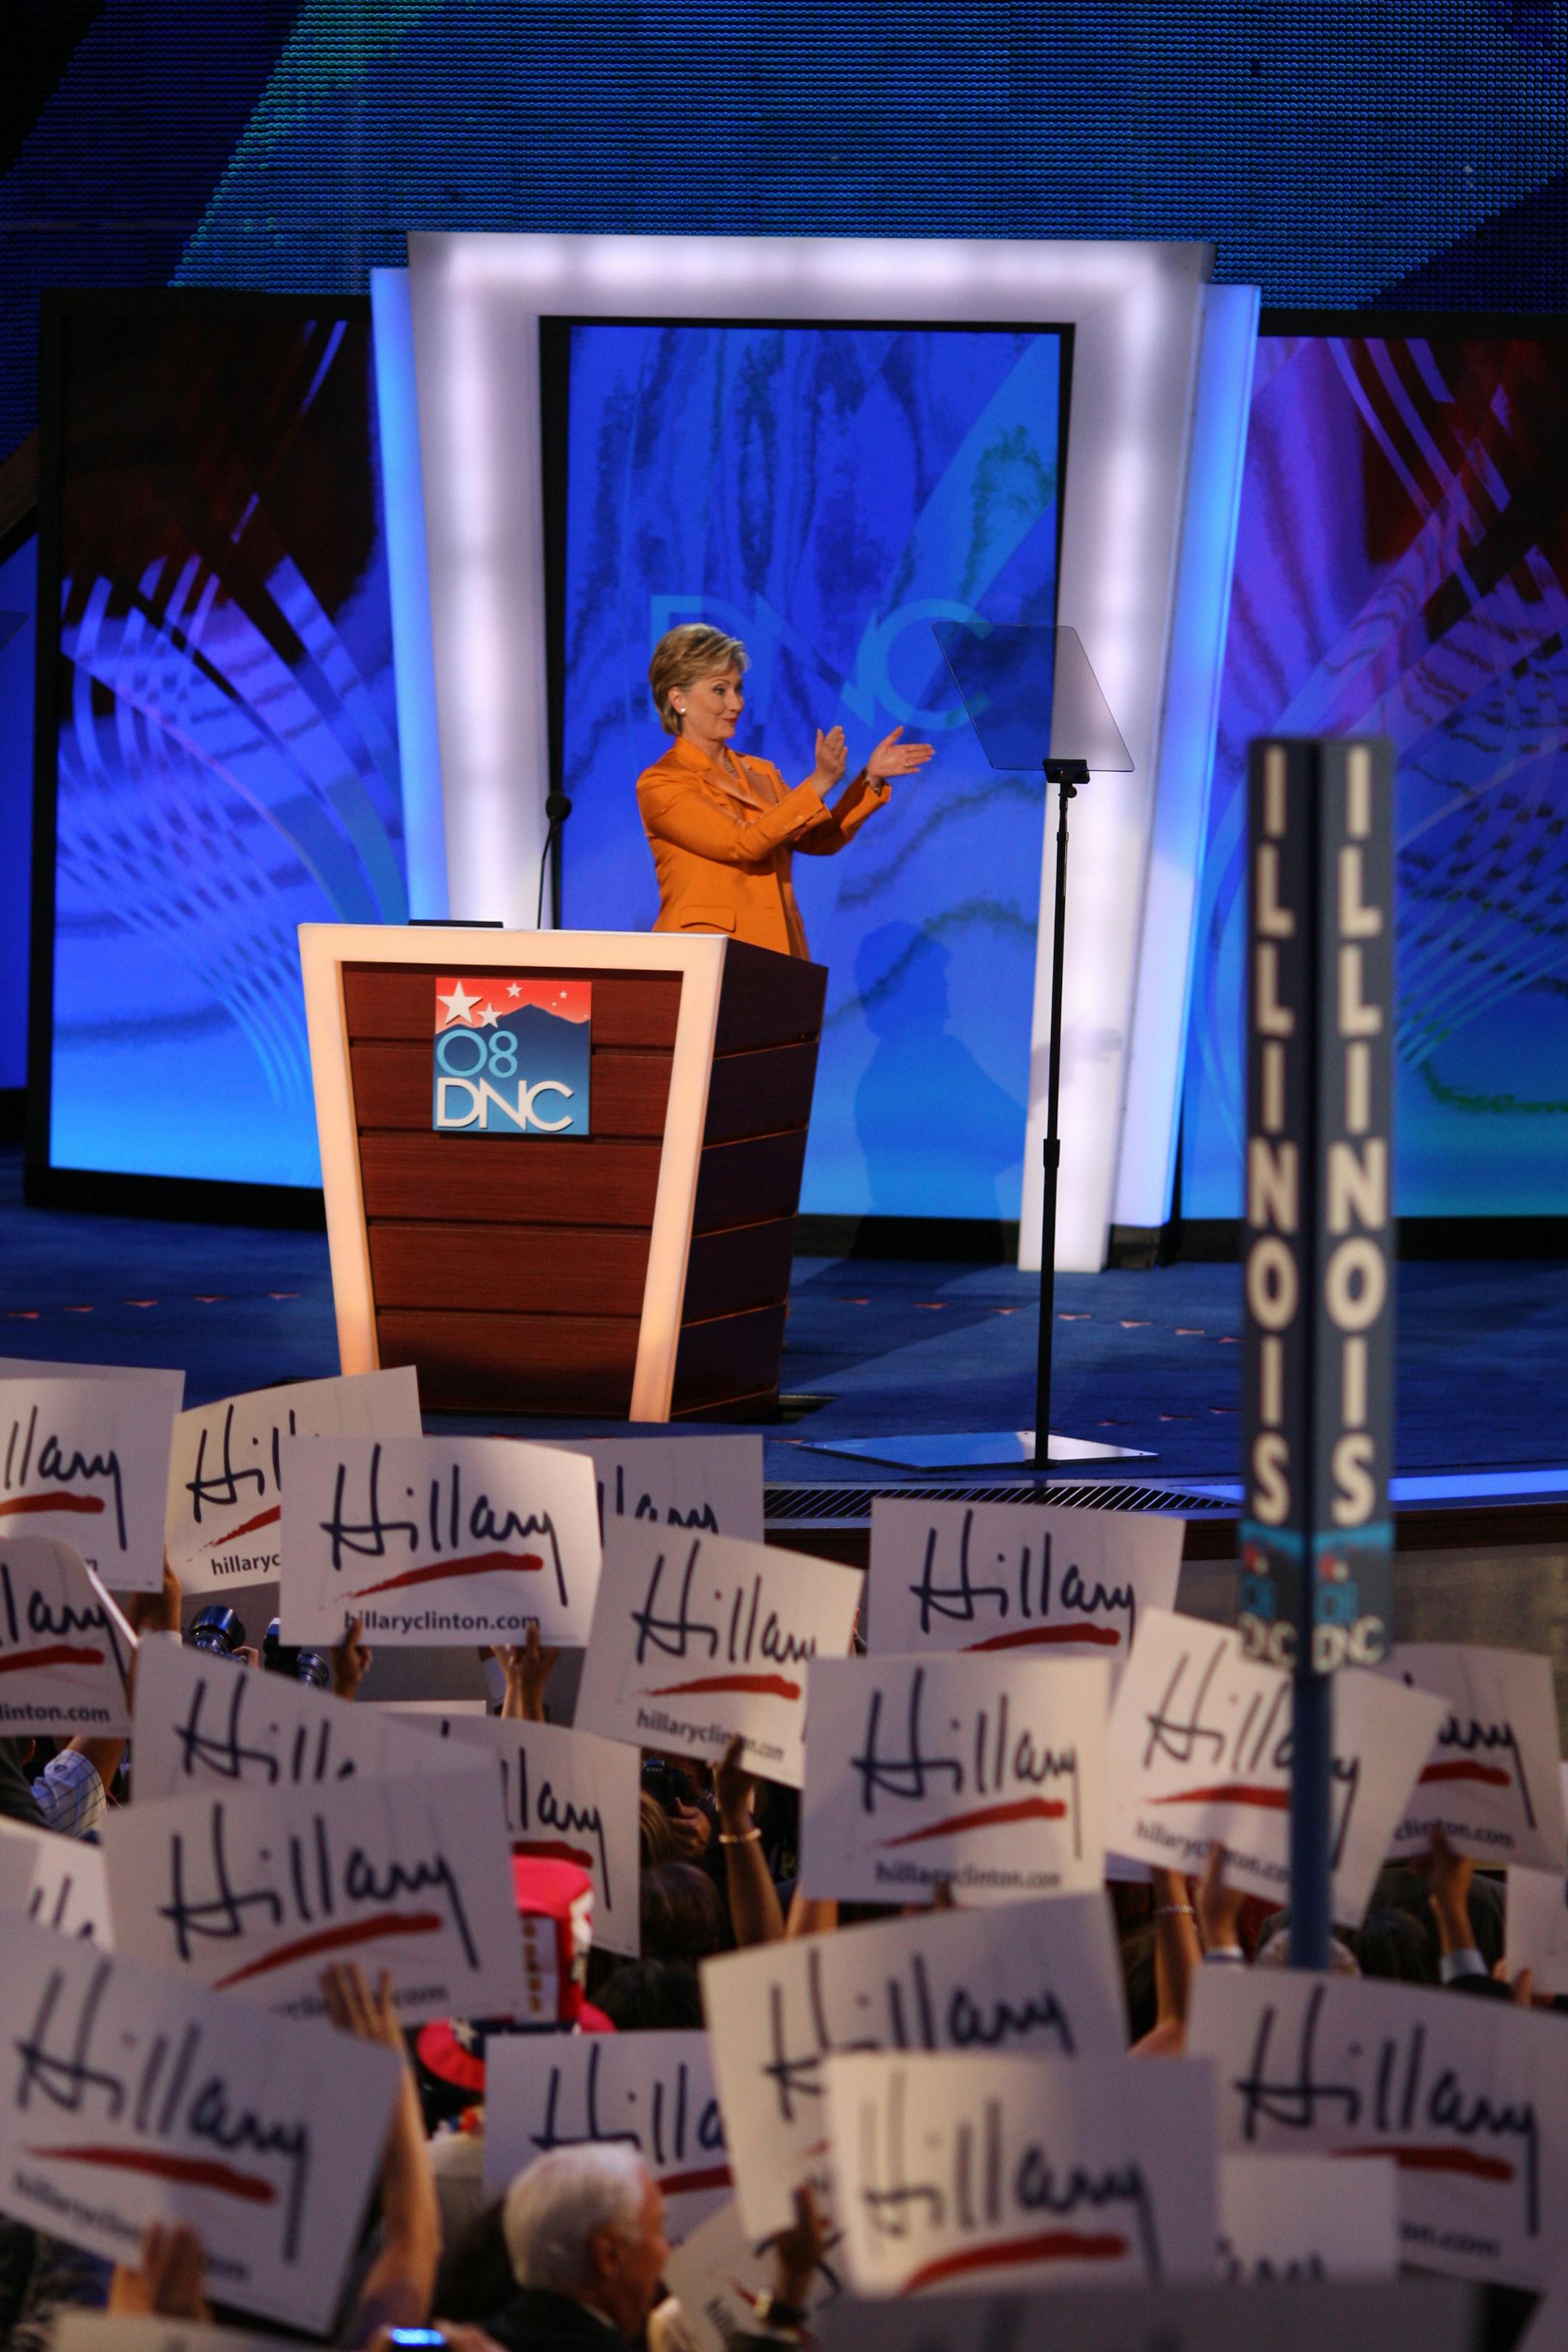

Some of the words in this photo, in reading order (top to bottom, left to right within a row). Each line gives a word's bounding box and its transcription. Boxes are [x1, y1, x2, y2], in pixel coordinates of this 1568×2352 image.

[436, 1077, 574, 1132] DNC
[1244, 746, 1301, 1527] ILLINOIS
[1323, 746, 1389, 1527] ILLINOIS
[319, 1442, 568, 1608] Hillary
[909, 1508, 1136, 1657] Hillary
[851, 1665, 1082, 1861] Hillary
[160, 1800, 481, 1972] Hillary
[15, 1956, 310, 2266] Hillary
[862, 2066, 1162, 2285] Hillary
[1233, 1982, 1540, 2238] Hillary
